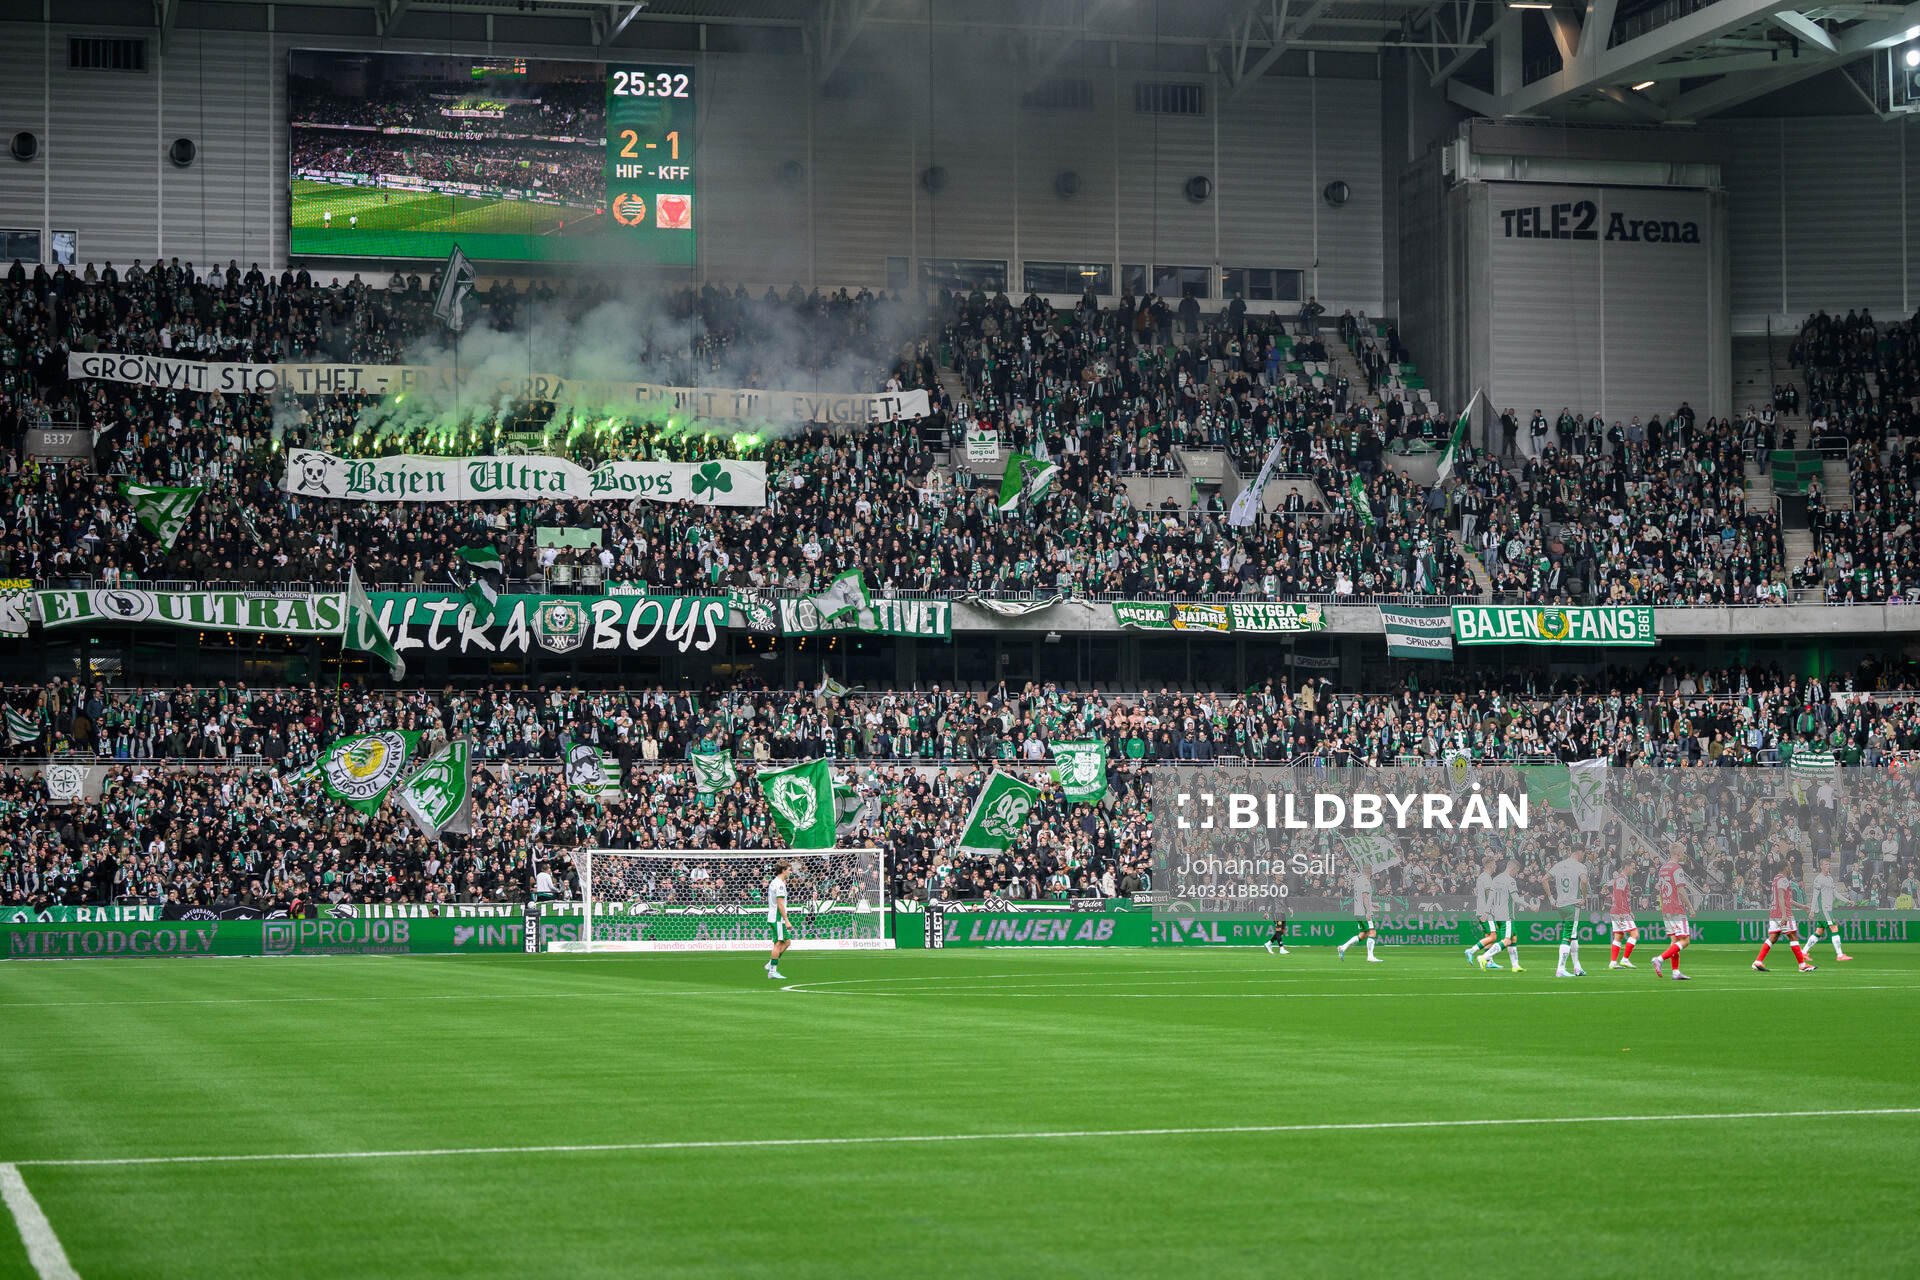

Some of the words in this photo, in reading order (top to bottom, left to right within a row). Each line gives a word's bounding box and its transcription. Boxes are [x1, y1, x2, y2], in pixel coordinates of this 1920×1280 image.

[613, 71, 689, 98] 25:32
[620, 129, 638, 158] 2
[666, 131, 679, 160] 1
[616, 164, 643, 179] HIF
[658, 165, 690, 180] KFF
[1501, 201, 1598, 241] TELE2
[1604, 212, 1700, 244] Arena
[82, 354, 208, 391] GRÖNVIT
[792, 396, 903, 422] EVIGHET!
[43, 433, 73, 445] B337
[344, 459, 446, 499] Bajen
[468, 462, 566, 493] Ultra
[589, 464, 673, 496] Boys
[155, 593, 342, 631] ULTRAS
[780, 599, 949, 635] KOTIVET
[1117, 608, 1165, 621] NACKA
[1177, 610, 1227, 624] BAJARE
[1232, 603, 1297, 618] SNYGGA
[1235, 616, 1300, 630] BAJARE
[1385, 614, 1397, 623] NI
[1397, 616, 1417, 626] KAN
[1457, 608, 1538, 639] BAJEN
[1568, 608, 1636, 639] FANS
[357, 597, 530, 654] ULTRA
[591, 598, 725, 653] BOYS
[301, 920, 410, 945] PROJOB
[525, 915, 536, 952] SELECT
[934, 911, 943, 948] SELECT
[970, 919, 1072, 941] LINJEN
[1074, 919, 1116, 940] AB
[1376, 934, 1460, 945] AMILJEARBETE
[1530, 922, 1593, 941] Sefa
[1837, 913, 1908, 941] MÅLERI
[9, 928, 217, 954] METODGOLV
